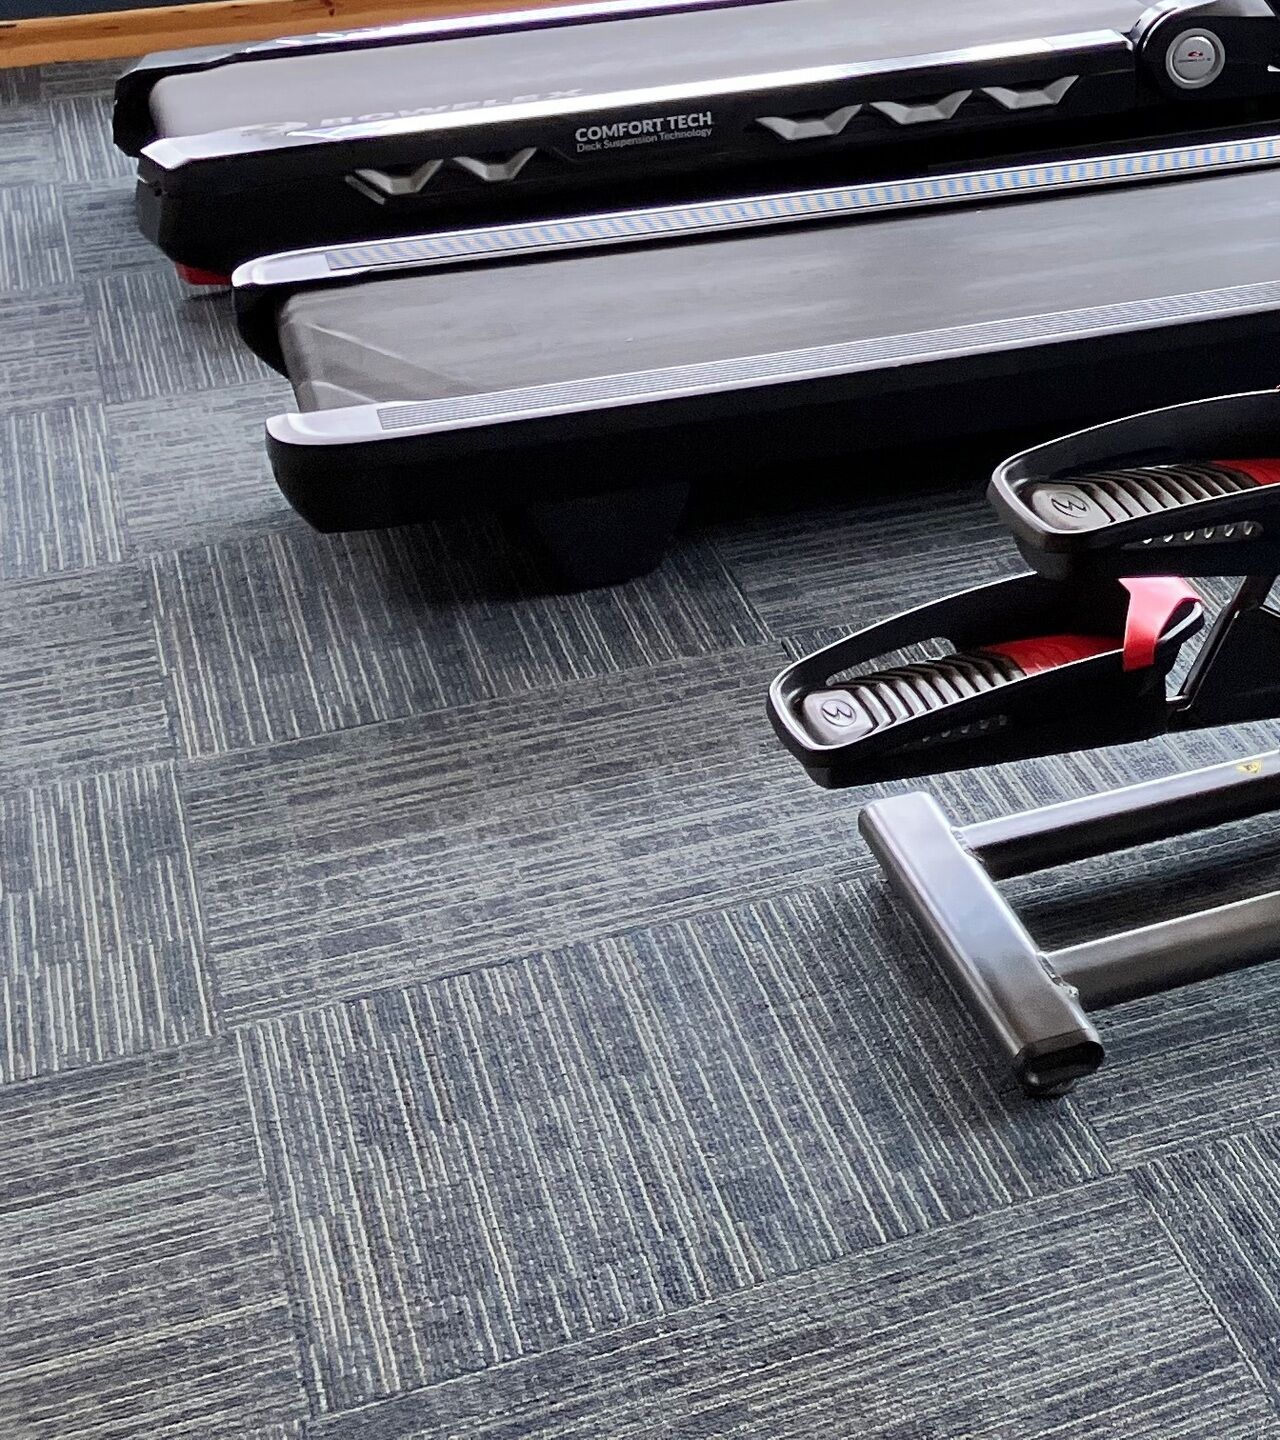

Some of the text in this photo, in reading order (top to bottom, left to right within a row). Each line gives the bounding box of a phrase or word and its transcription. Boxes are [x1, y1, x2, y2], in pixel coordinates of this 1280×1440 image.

[575, 110, 713, 142] COMFORT TECH
[576, 127, 713, 153] Deck Suspension Technology
